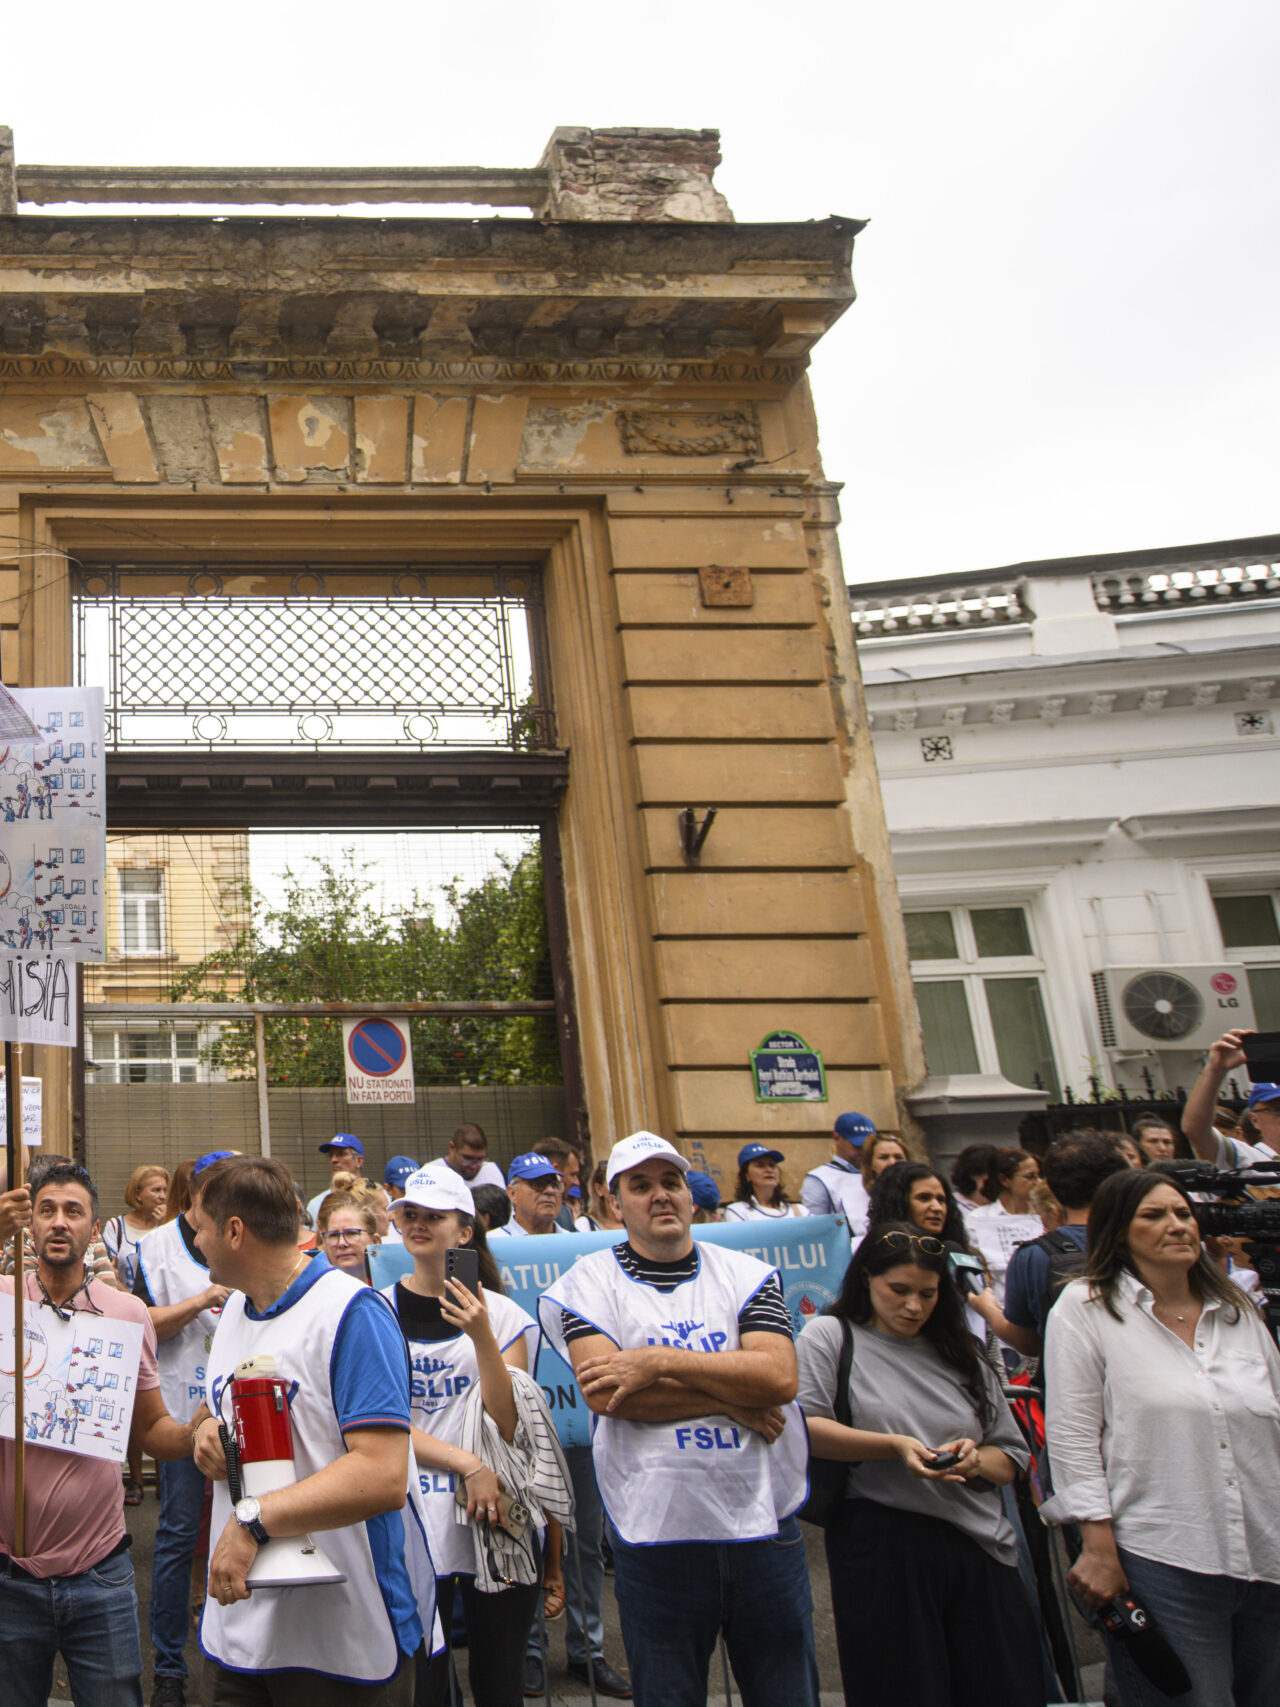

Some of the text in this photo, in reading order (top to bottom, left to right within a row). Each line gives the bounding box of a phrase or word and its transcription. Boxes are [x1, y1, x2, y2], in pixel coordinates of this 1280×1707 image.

[1217, 997, 1240, 1008] LG
[348, 1076, 364, 1089] NU
[411, 1376, 471, 1398] SLIP
[676, 1427, 742, 1450] FSLI
[419, 1474, 455, 1495] SLI
